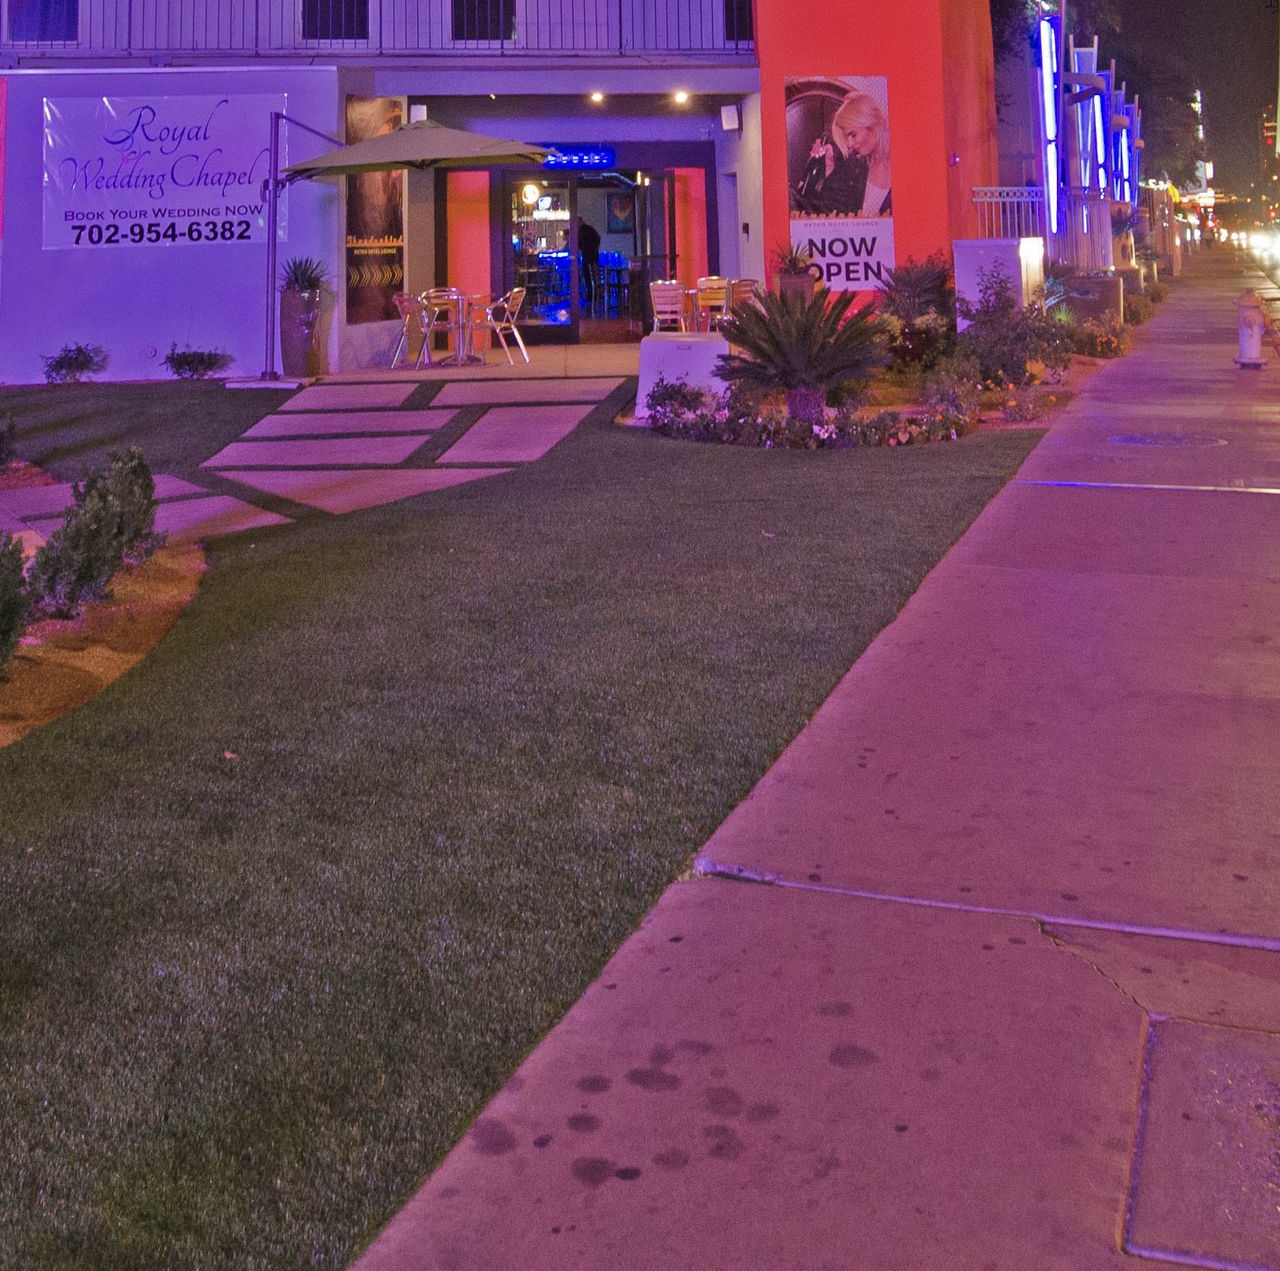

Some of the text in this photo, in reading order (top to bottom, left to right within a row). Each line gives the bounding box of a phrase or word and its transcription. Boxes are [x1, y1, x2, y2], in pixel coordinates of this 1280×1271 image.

[103, 99, 228, 155] Royal
[60, 148, 270, 200] Wedding Chapel
[64, 203, 264, 222] BOOK YOUR WEDDING NOW
[71, 219, 251, 245] 702-954-6382
[807, 236, 877, 258] NOW
[807, 261, 883, 282] OPEN
